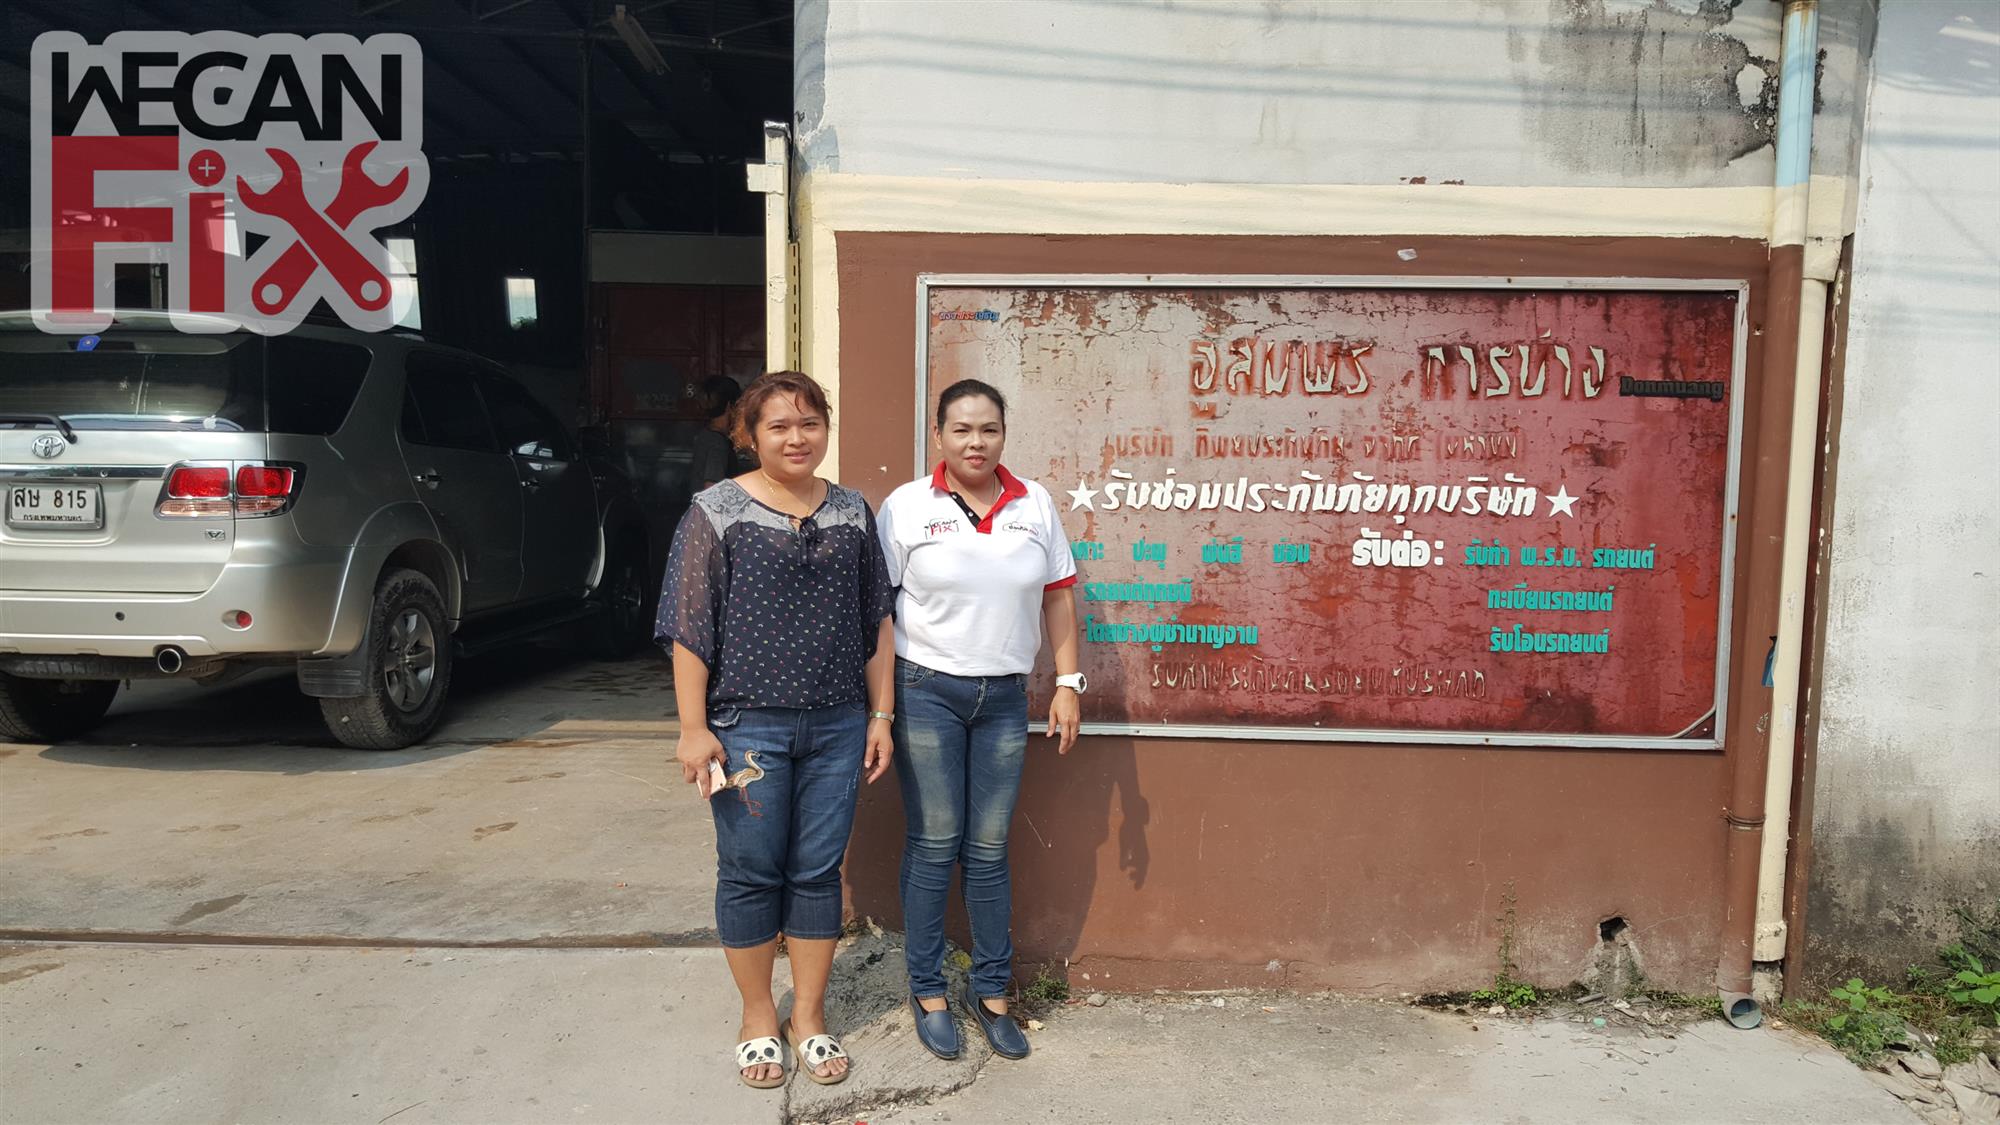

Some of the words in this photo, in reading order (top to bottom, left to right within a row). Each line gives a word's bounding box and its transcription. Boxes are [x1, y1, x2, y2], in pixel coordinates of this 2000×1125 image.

[1620, 376, 1724, 402] Donmuang
[53, 489, 88, 509] 815
[23, 513, 83, 522] กรงเทพมหานคร
[1200, 535, 1246, 564] พ่นสี
[1464, 538, 1510, 566] รับทำ
[1520, 547, 1582, 567] พ.ร.บ.
[1592, 543, 1657, 569] รถยนต์
[1487, 582, 1615, 611] ทะเบียนรถยนต์
[1489, 624, 1611, 653] รับโอนรถยนต์
